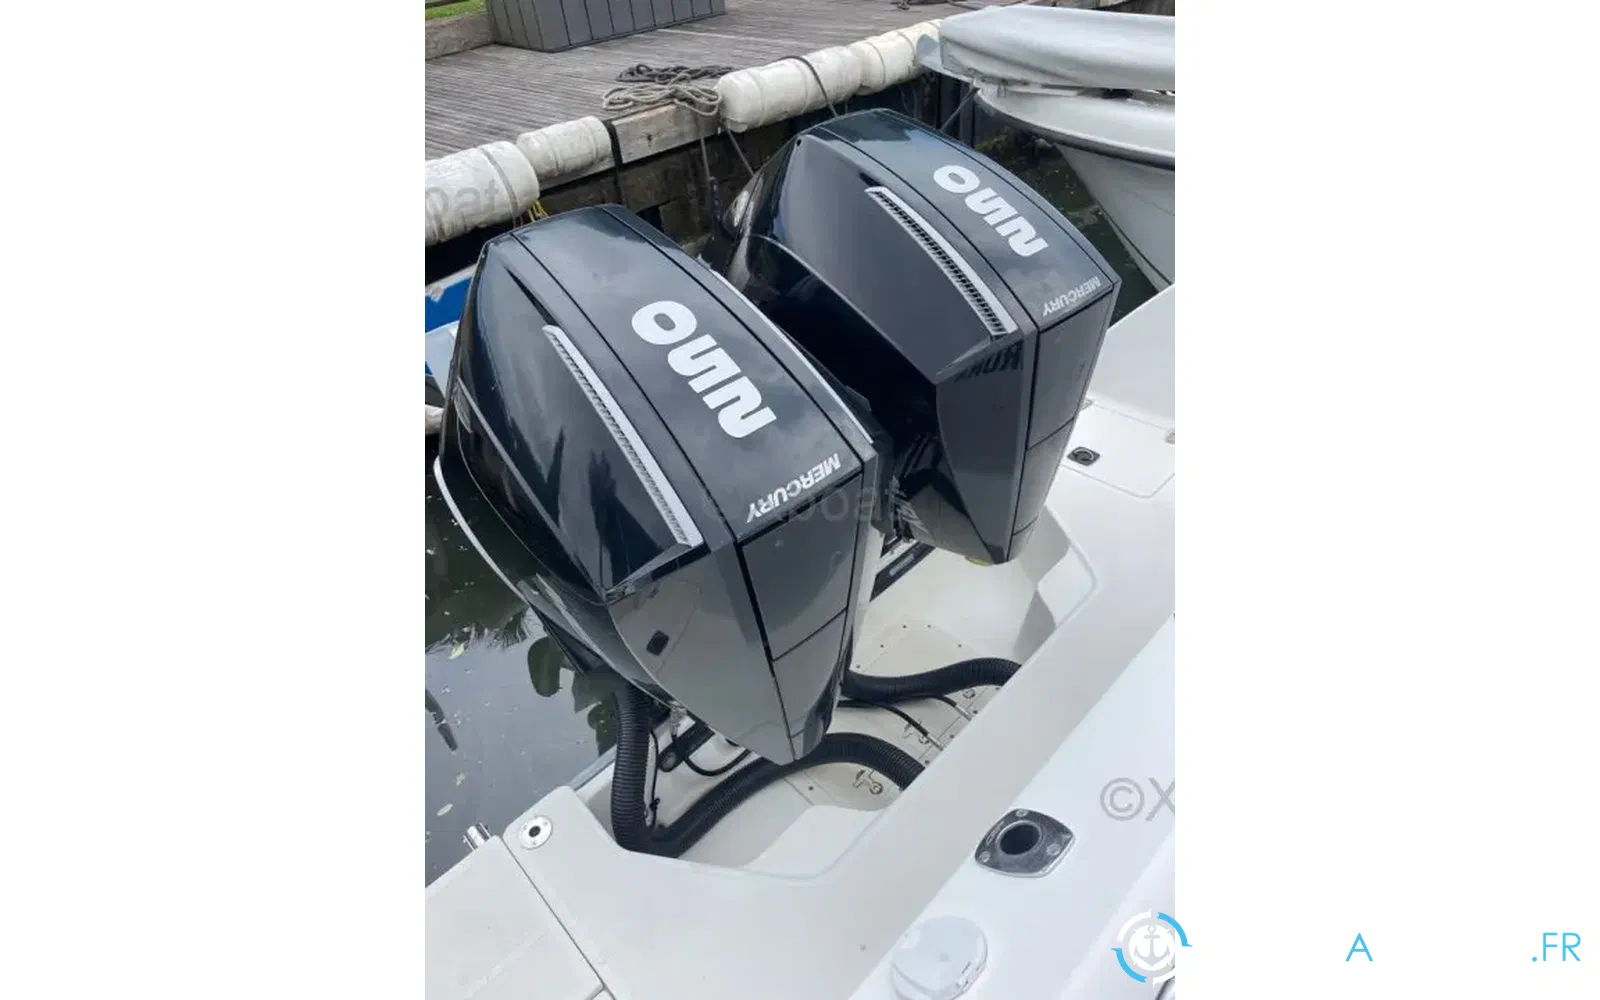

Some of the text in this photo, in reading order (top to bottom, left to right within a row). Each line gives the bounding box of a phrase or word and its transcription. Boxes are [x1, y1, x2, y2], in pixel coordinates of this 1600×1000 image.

[933, 164, 1049, 258] 250
[1042, 275, 1102, 318] MERCURY
[632, 300, 777, 439] 250
[746, 453, 841, 523] MERCURY
